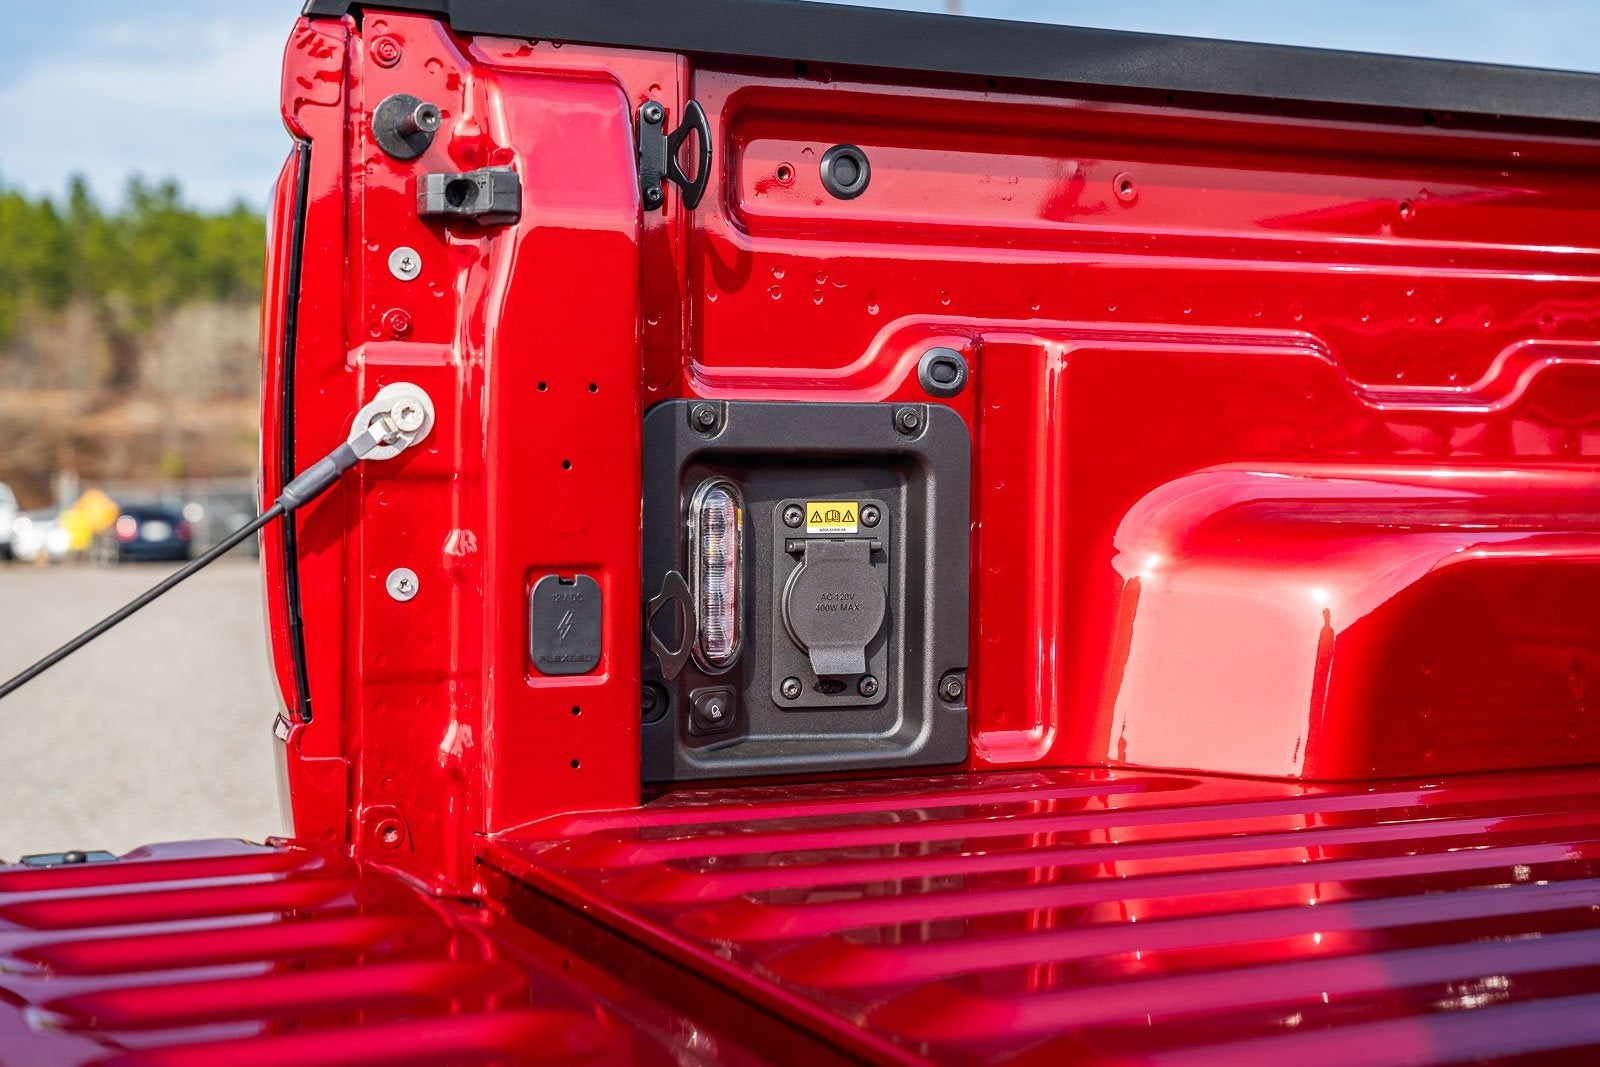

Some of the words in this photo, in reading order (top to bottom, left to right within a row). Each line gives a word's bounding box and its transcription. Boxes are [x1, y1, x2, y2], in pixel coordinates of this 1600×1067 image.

[570, 592, 584, 603] DC
[821, 592, 833, 601] AC
[835, 592, 855, 601] 120V
[815, 603, 838, 611] 400W
[840, 602, 860, 611] MAX
